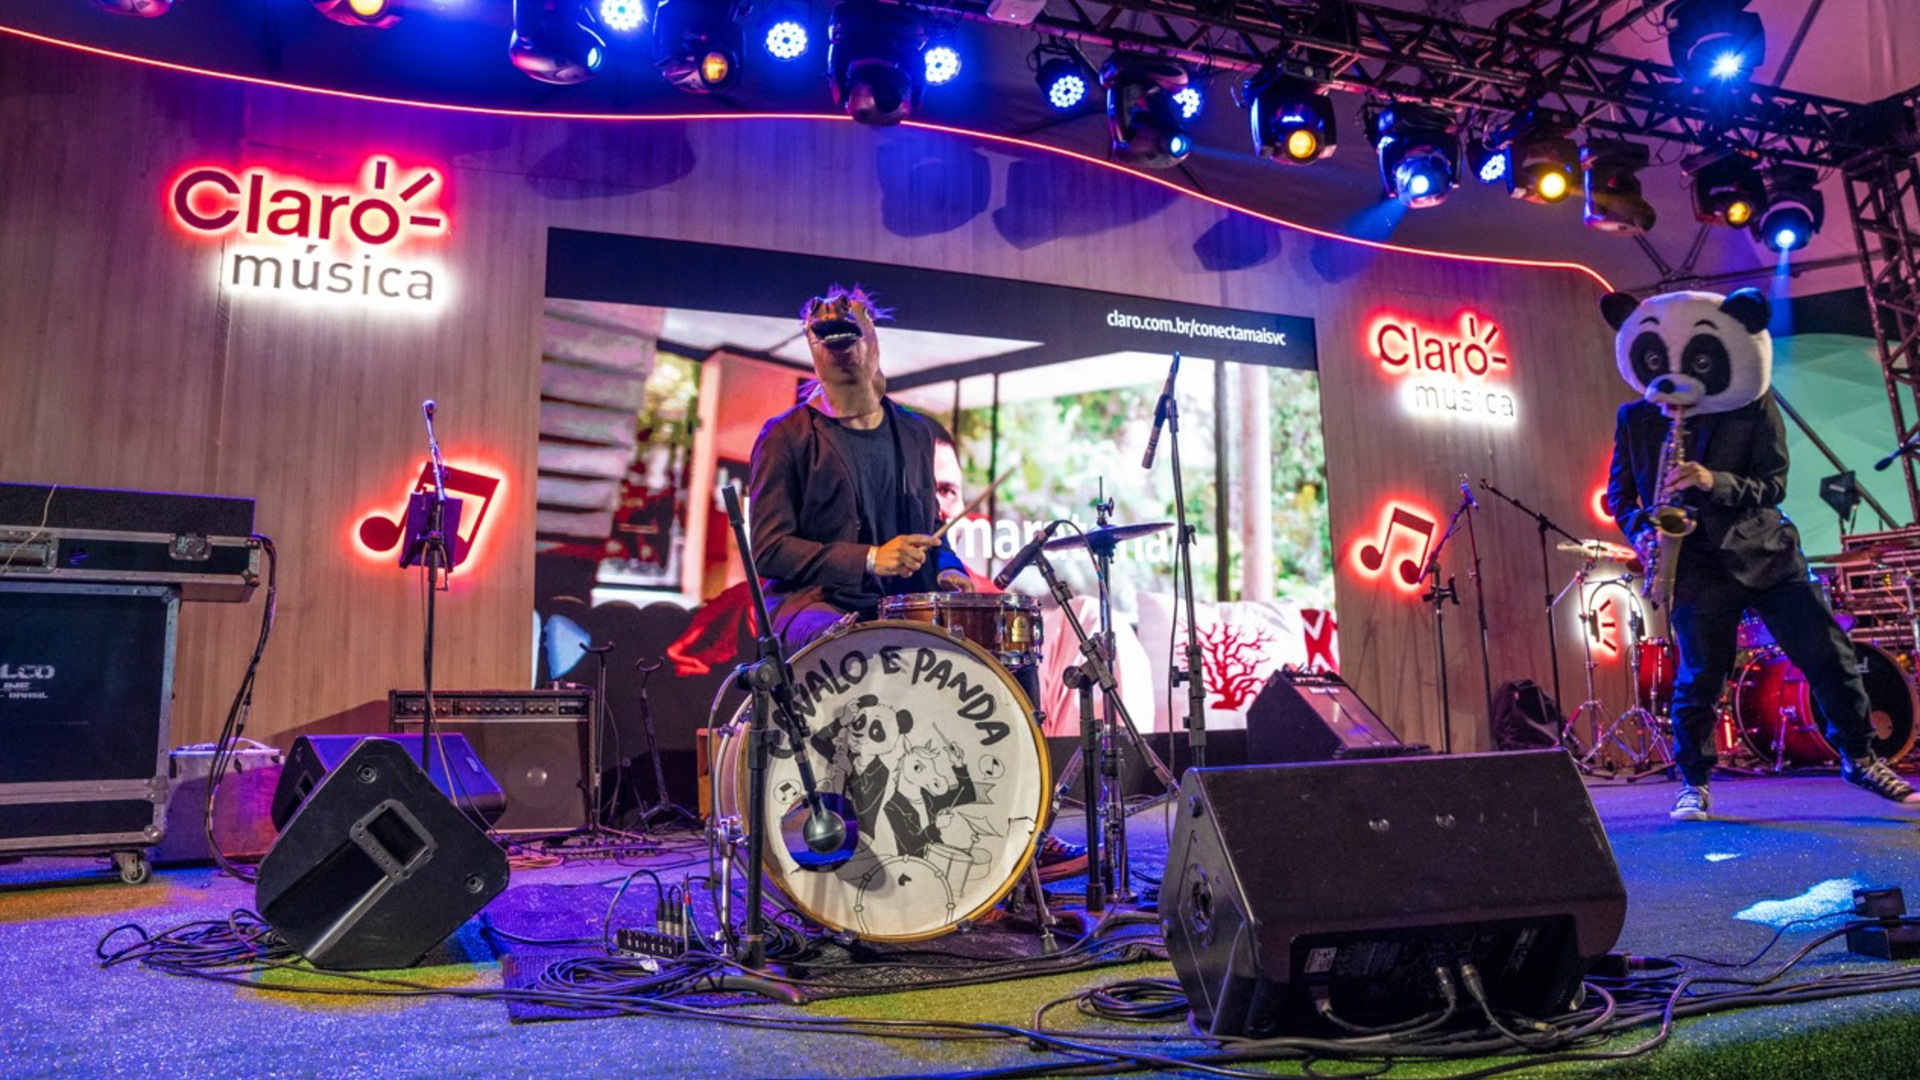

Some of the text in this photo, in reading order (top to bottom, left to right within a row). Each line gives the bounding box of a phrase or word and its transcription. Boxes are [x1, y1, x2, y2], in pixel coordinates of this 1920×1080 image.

[173, 164, 408, 245] Claro
[232, 244, 433, 300] música
[1106, 309, 1287, 346] claro.com.br/conectamaisvc
[1377, 321, 1492, 376] Claro
[879, 645, 905, 675] E
[910, 647, 1011, 746] PANDA
